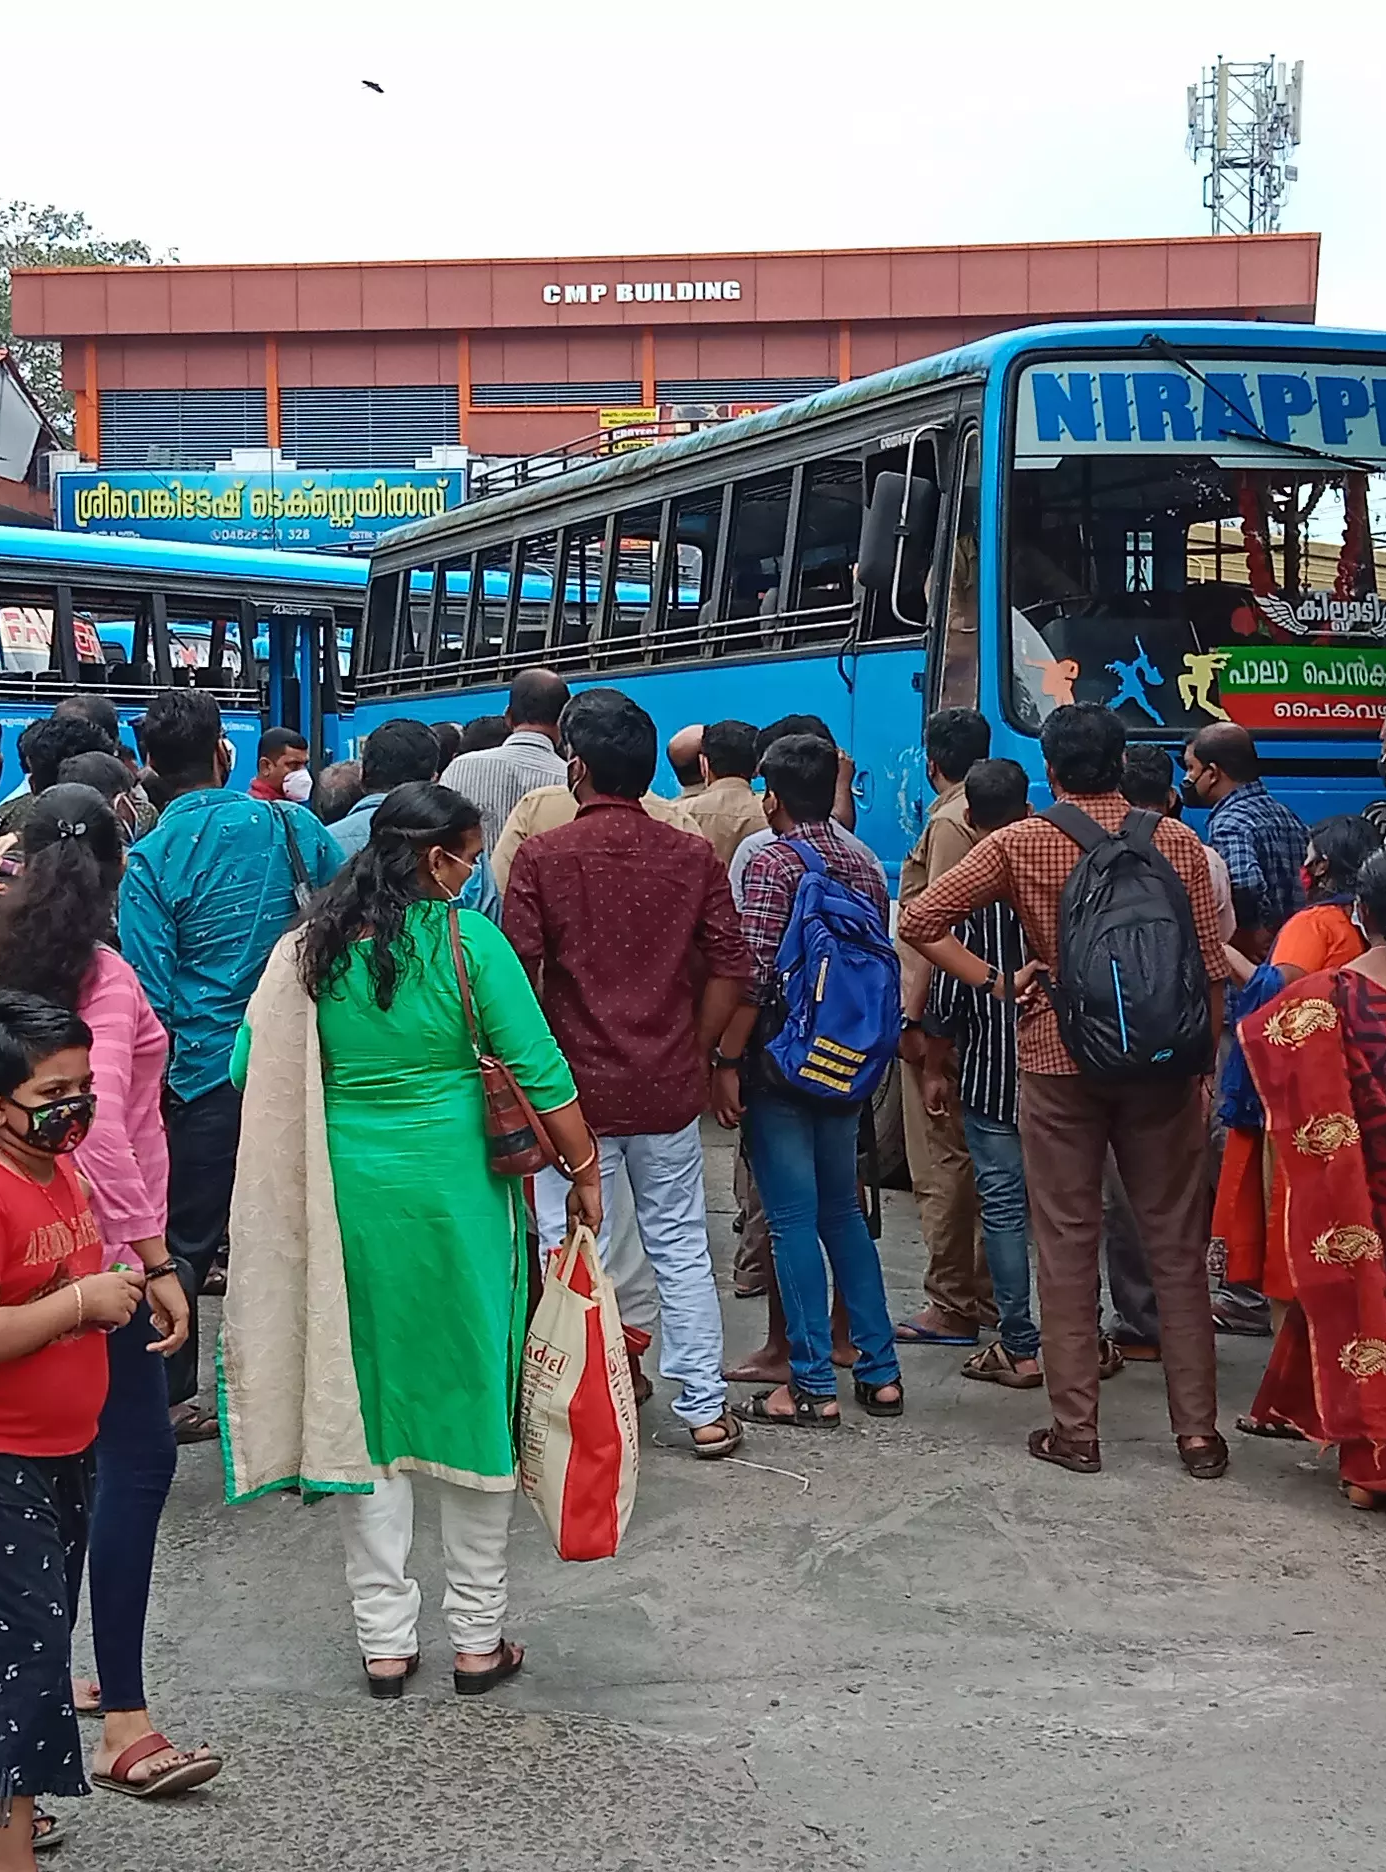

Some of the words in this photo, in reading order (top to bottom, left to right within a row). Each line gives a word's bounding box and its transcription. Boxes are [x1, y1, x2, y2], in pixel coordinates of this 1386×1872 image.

[543, 284, 607, 303] CMP
[616, 280, 741, 302] BUILDING
[288, 530, 310, 540] 328
[1296, 592, 1382, 632] കില്ലാടി
[1228, 658, 1289, 685] പാലാ
